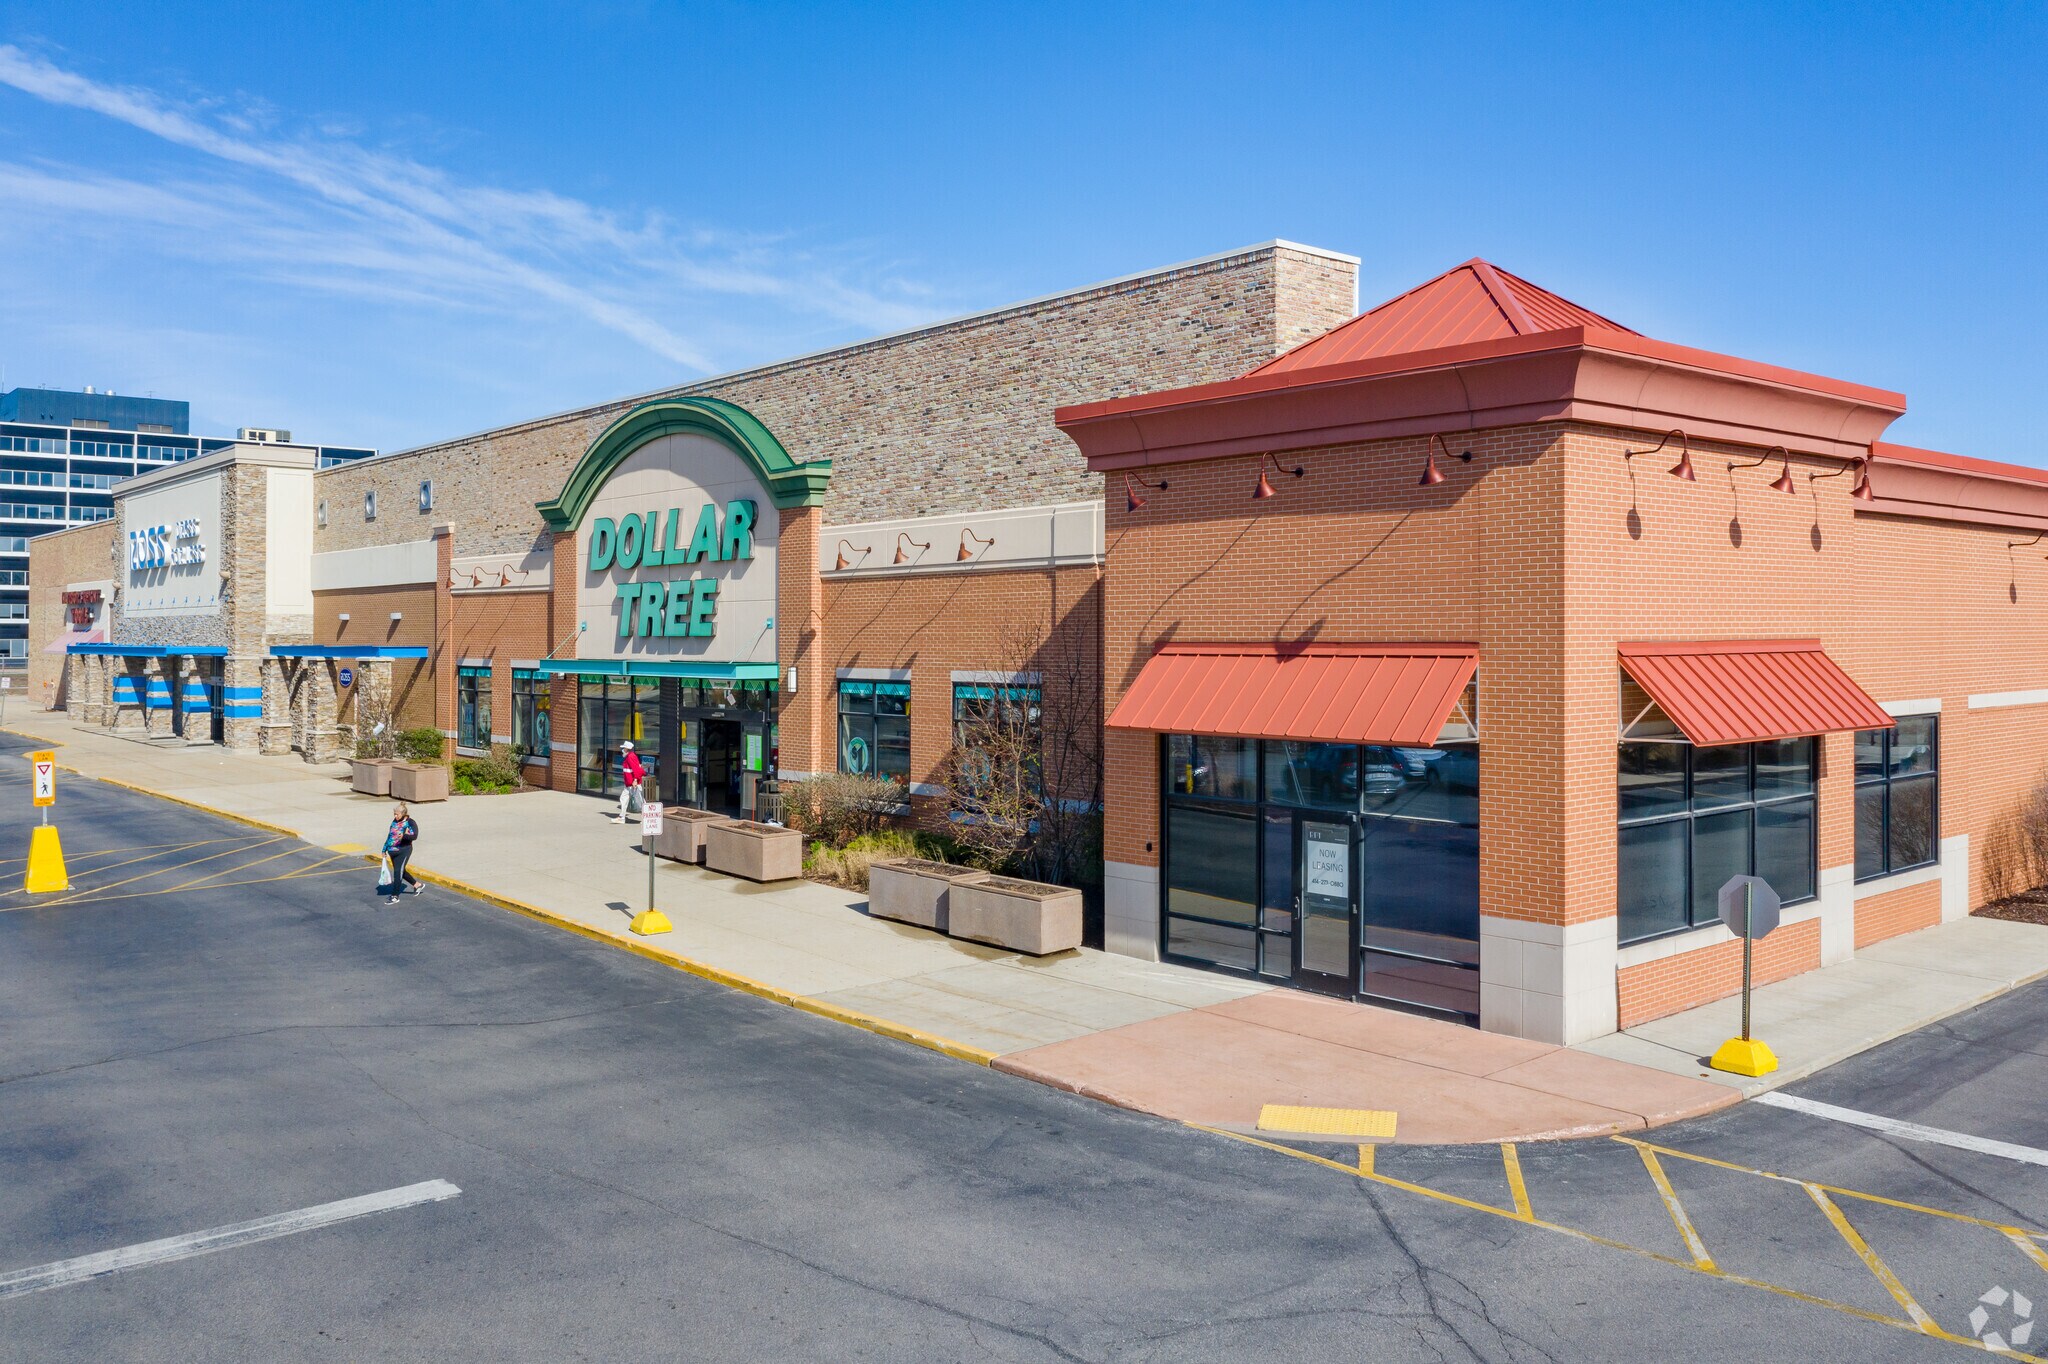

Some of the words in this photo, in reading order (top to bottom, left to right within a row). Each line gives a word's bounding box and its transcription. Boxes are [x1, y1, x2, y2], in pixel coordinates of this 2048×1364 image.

[591, 500, 757, 571] DOLLAR
[617, 578, 718, 637] TREE
[1312, 860, 1344, 873] LEASING
[1319, 848, 1337, 859] NOW
